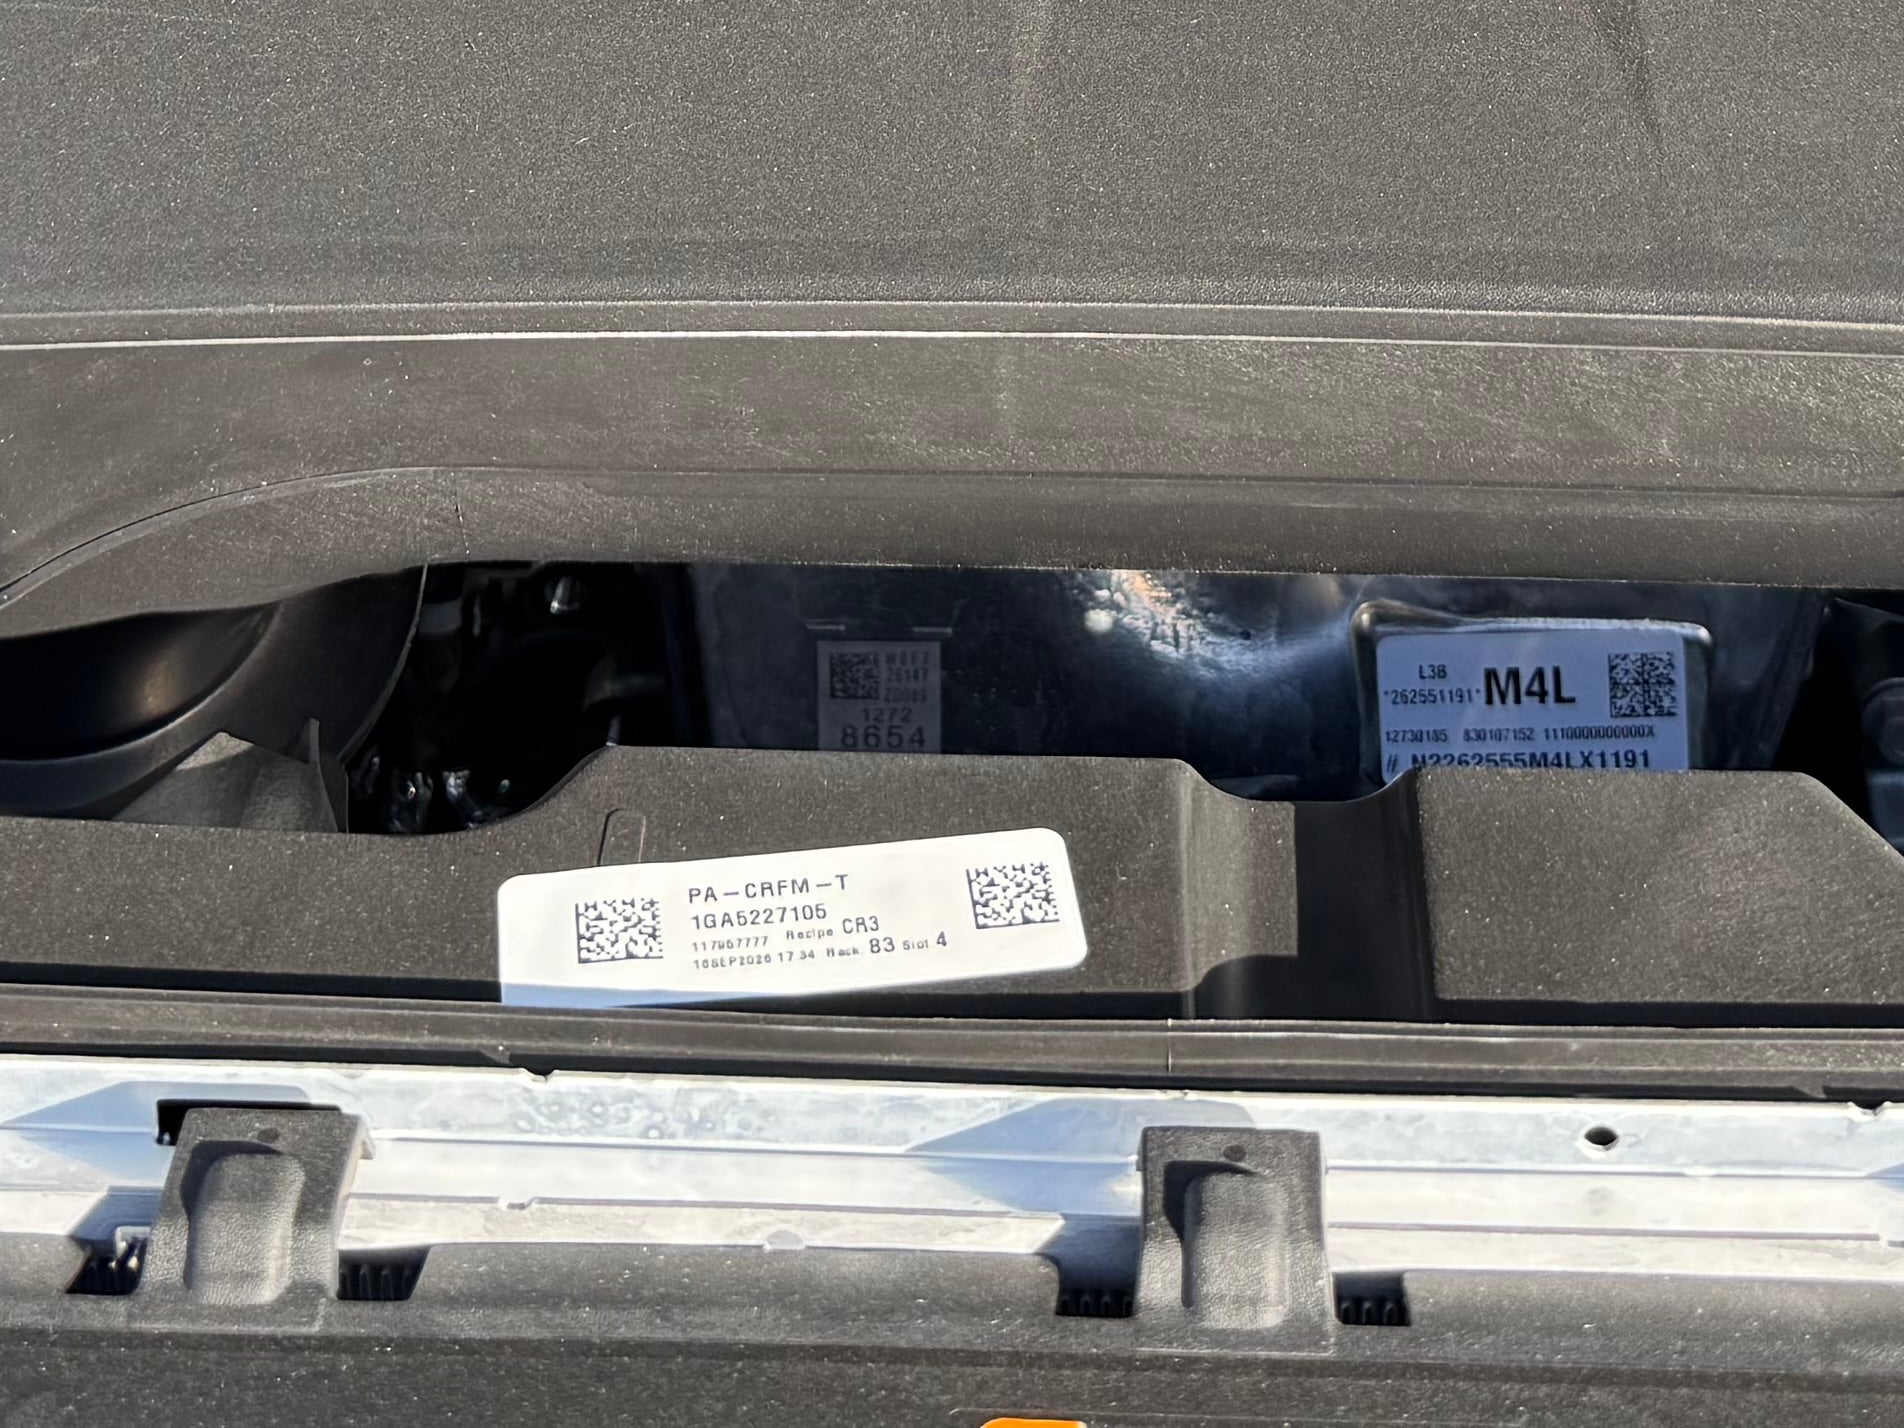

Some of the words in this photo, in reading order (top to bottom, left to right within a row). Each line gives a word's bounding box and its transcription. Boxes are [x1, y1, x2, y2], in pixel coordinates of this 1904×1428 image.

[1483, 666, 1577, 706] M4L
[862, 707, 912, 723] 1272
[841, 724, 926, 748] 8654
[842, 915, 880, 934] CR3
[869, 936, 896, 954] 83
[936, 930, 948, 947] 4
